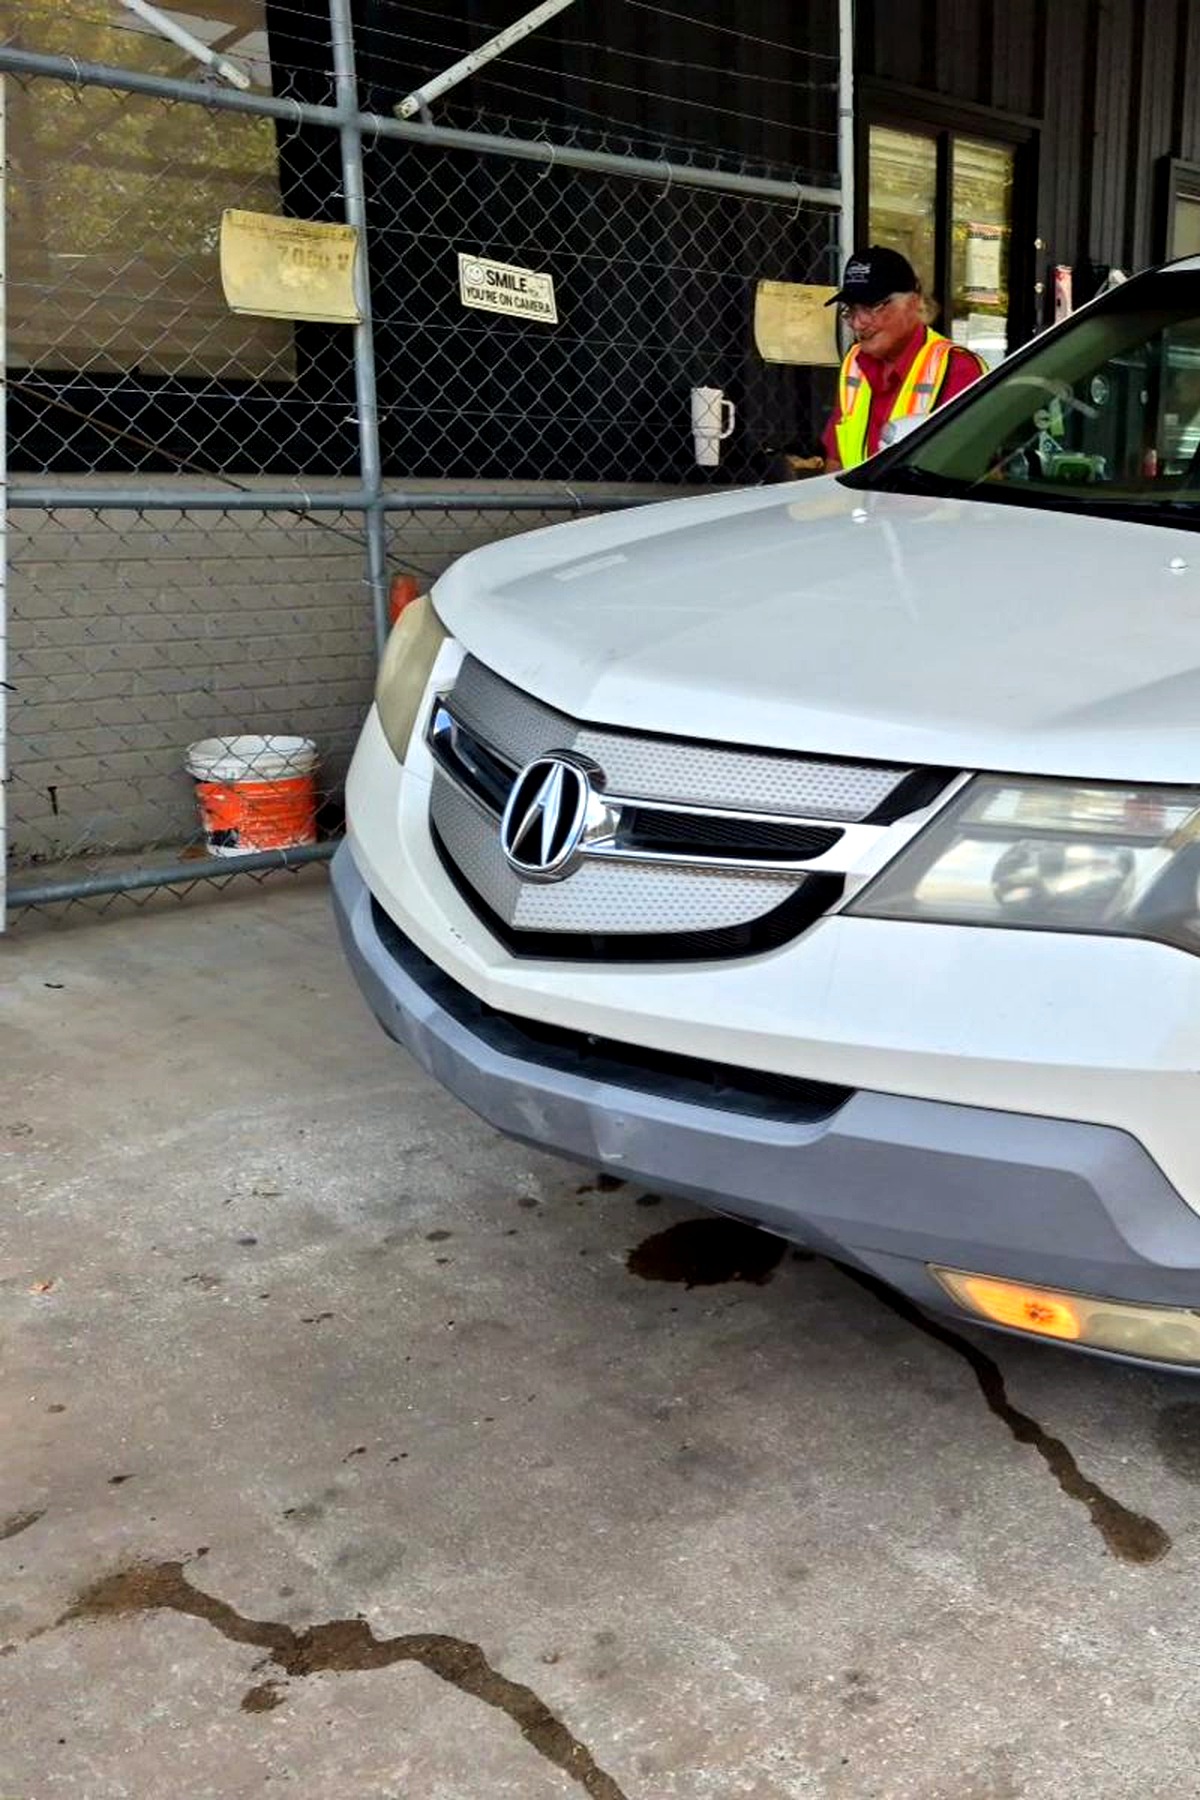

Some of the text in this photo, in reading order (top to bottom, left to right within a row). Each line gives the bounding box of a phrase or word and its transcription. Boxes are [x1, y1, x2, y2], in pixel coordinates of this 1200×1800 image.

[486, 270, 527, 293] SMILE
[466, 287, 551, 313] YOU'RE ON CAMERA
